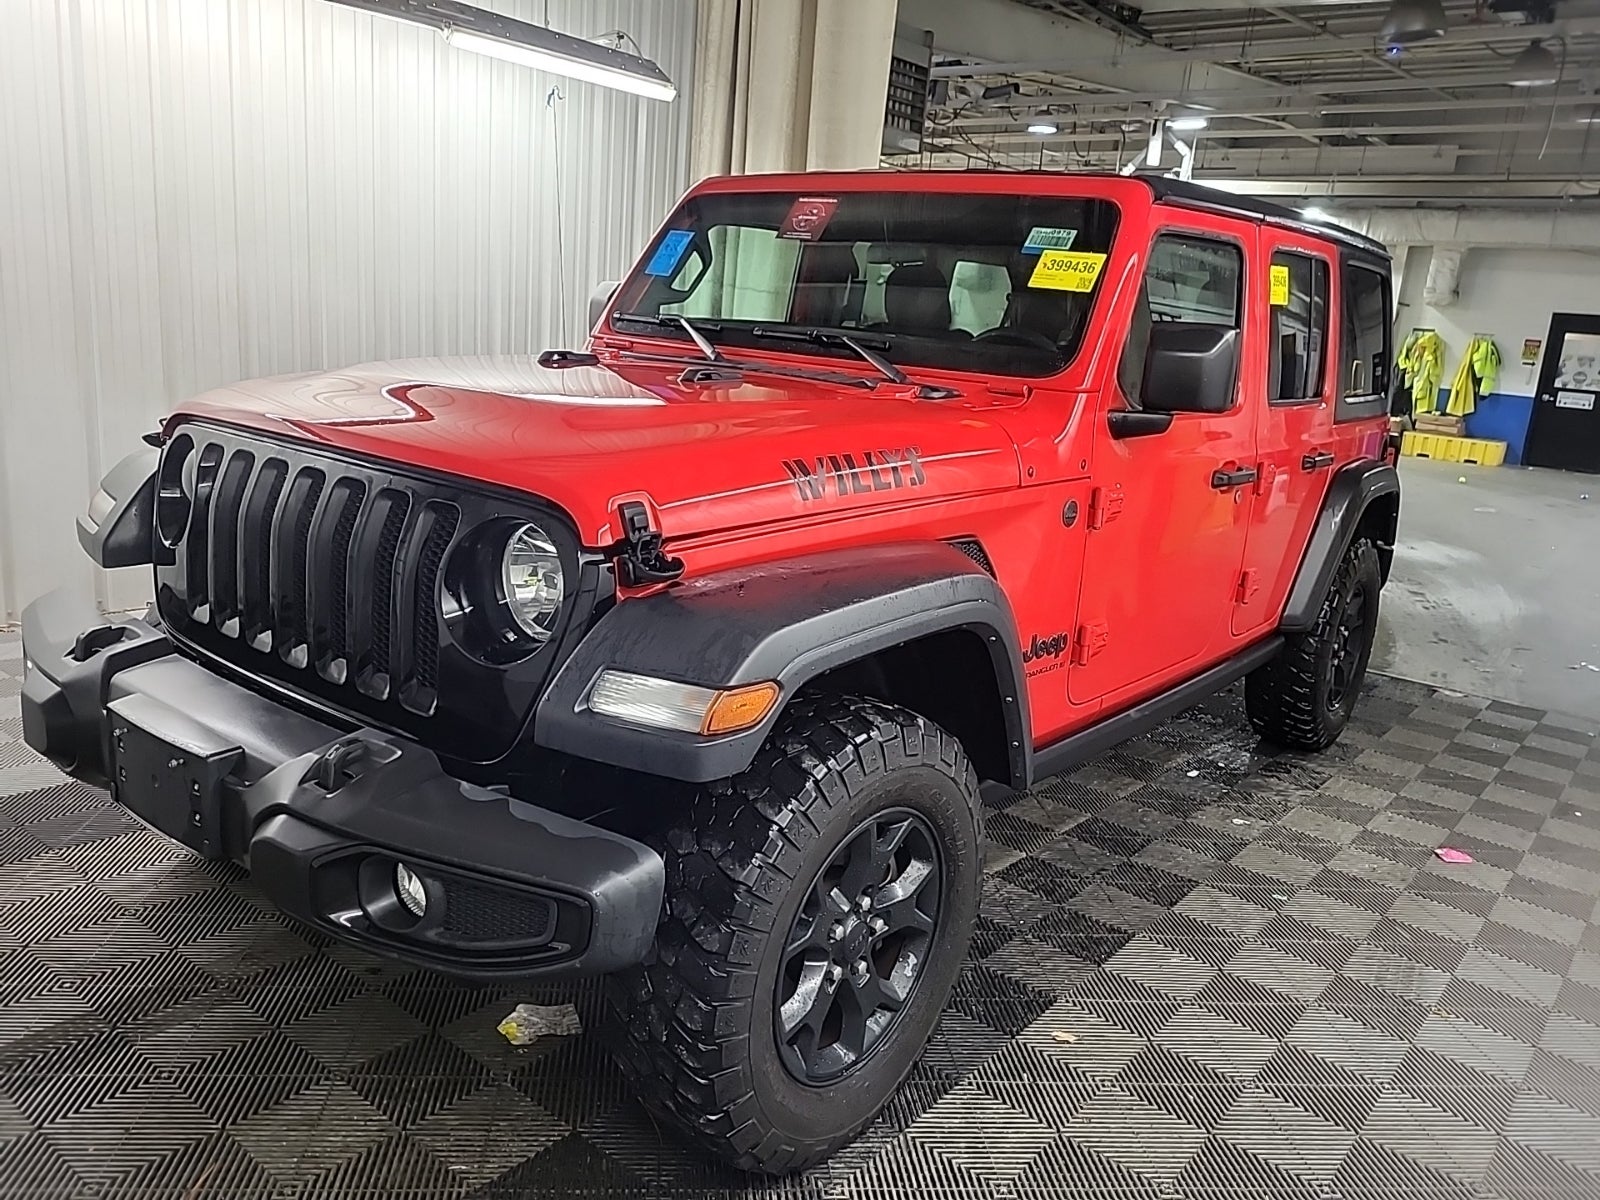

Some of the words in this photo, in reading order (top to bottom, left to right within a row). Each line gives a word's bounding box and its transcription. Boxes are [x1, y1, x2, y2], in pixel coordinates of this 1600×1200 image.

[1047, 258, 1097, 274] 399436
[780, 446, 926, 501] WILLYS
[1023, 633, 1068, 663] Jeep
